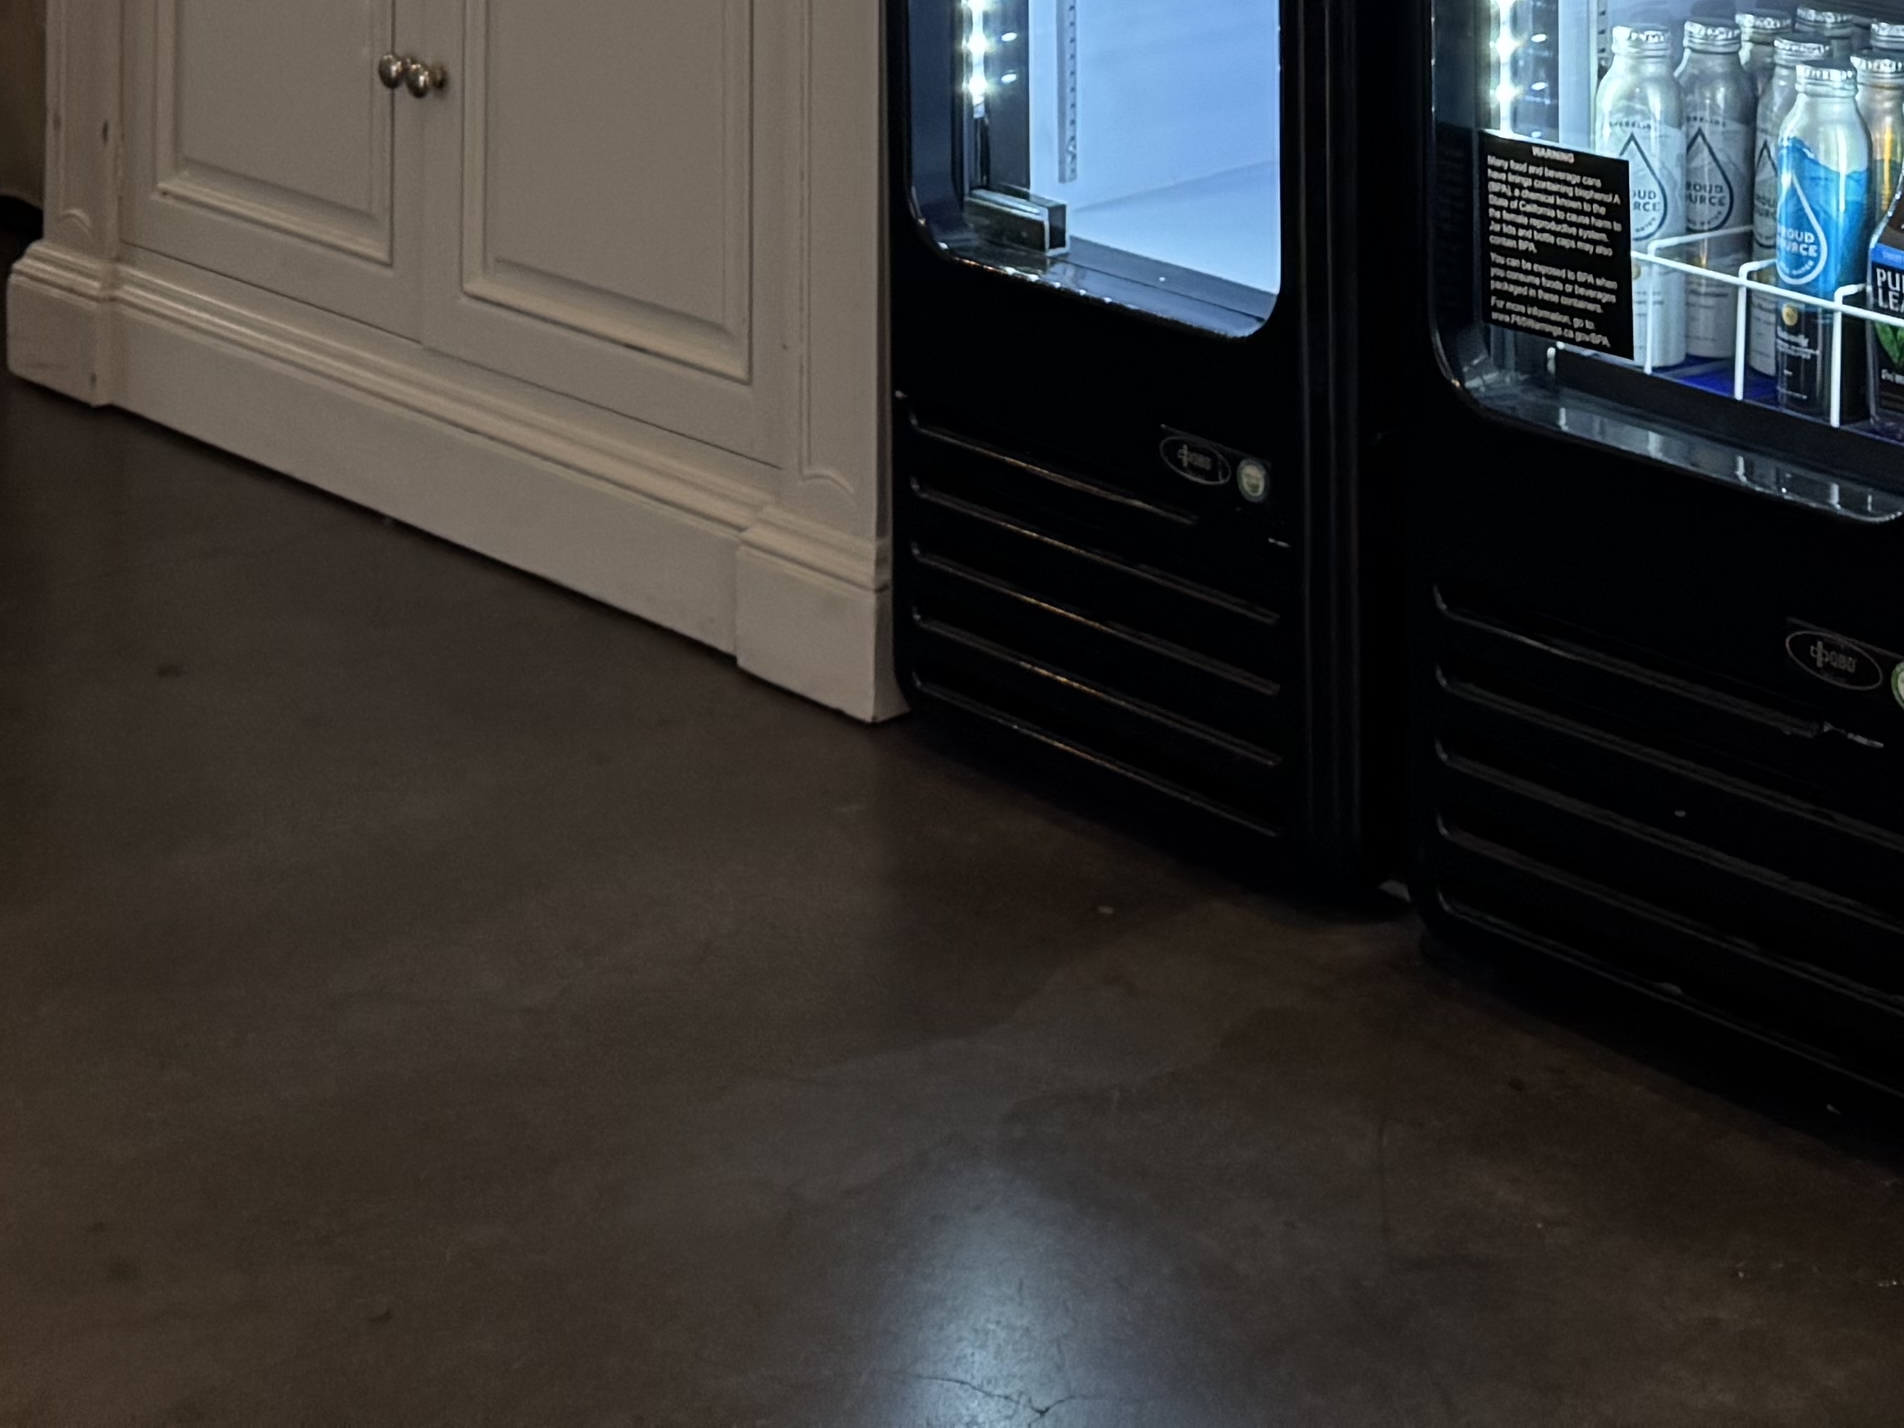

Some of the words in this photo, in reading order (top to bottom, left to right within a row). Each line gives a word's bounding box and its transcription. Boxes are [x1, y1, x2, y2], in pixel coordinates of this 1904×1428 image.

[1532, 145, 1574, 163] WARNING
[1582, 176, 1601, 188] cans
[1613, 194, 1620, 205] A
